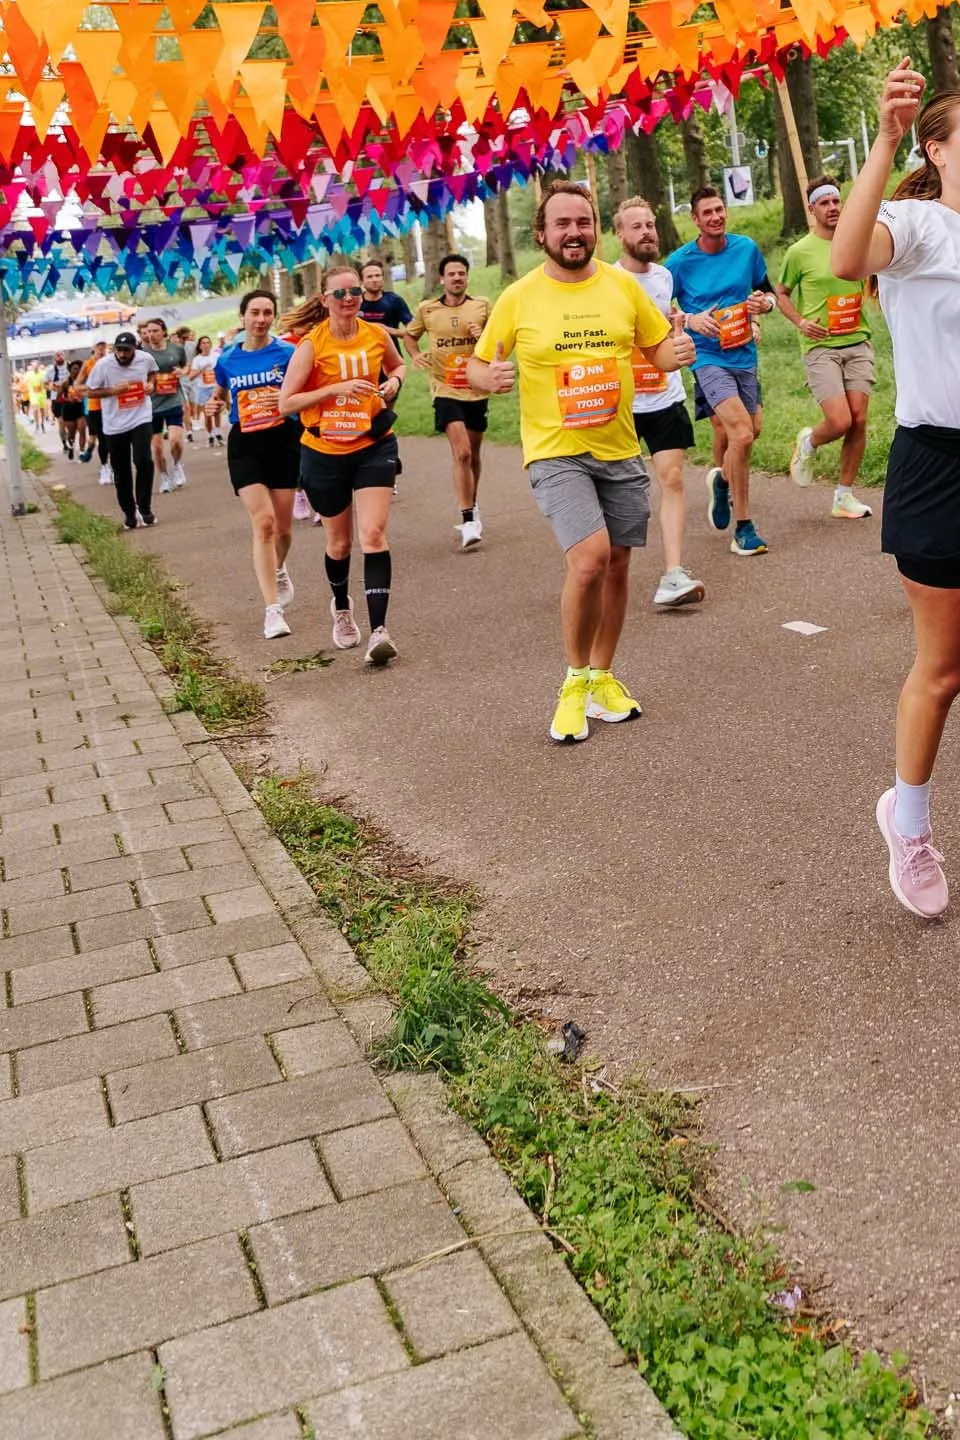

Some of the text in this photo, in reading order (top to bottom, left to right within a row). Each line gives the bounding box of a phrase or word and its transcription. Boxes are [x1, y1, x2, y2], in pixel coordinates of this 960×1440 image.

[563, 328, 607, 339] Run Fast.
[554, 340, 616, 351] Query Faster.
[586, 364, 605, 376] NN
[230, 369, 285, 389] PHILIPS
[558, 381, 620, 398] CLICKHOUSE
[576, 397, 605, 409] 17030
